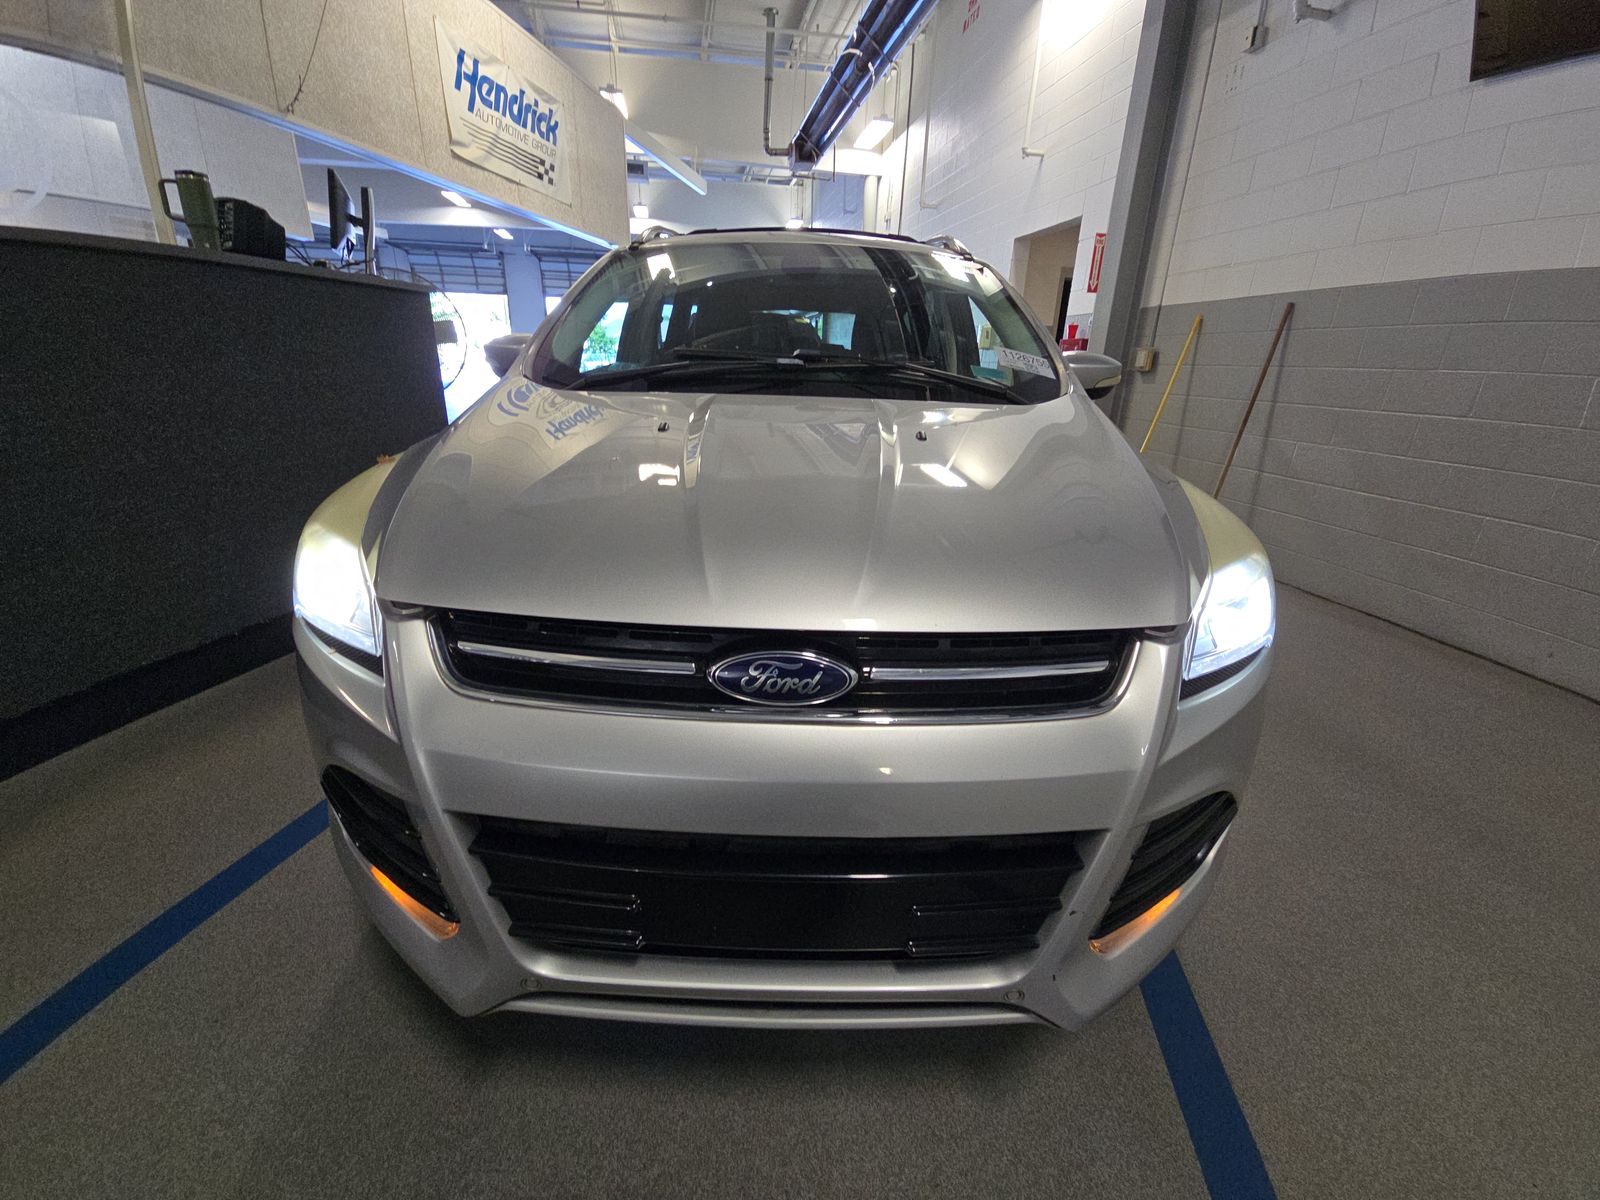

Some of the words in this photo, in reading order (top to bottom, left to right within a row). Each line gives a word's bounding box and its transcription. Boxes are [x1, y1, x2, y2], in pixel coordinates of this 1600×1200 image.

[454, 48, 559, 146] Hendrick
[475, 108, 529, 146] AUTOMOTIVE
[531, 139, 557, 158] GROUP
[740, 660, 823, 694] Ford
